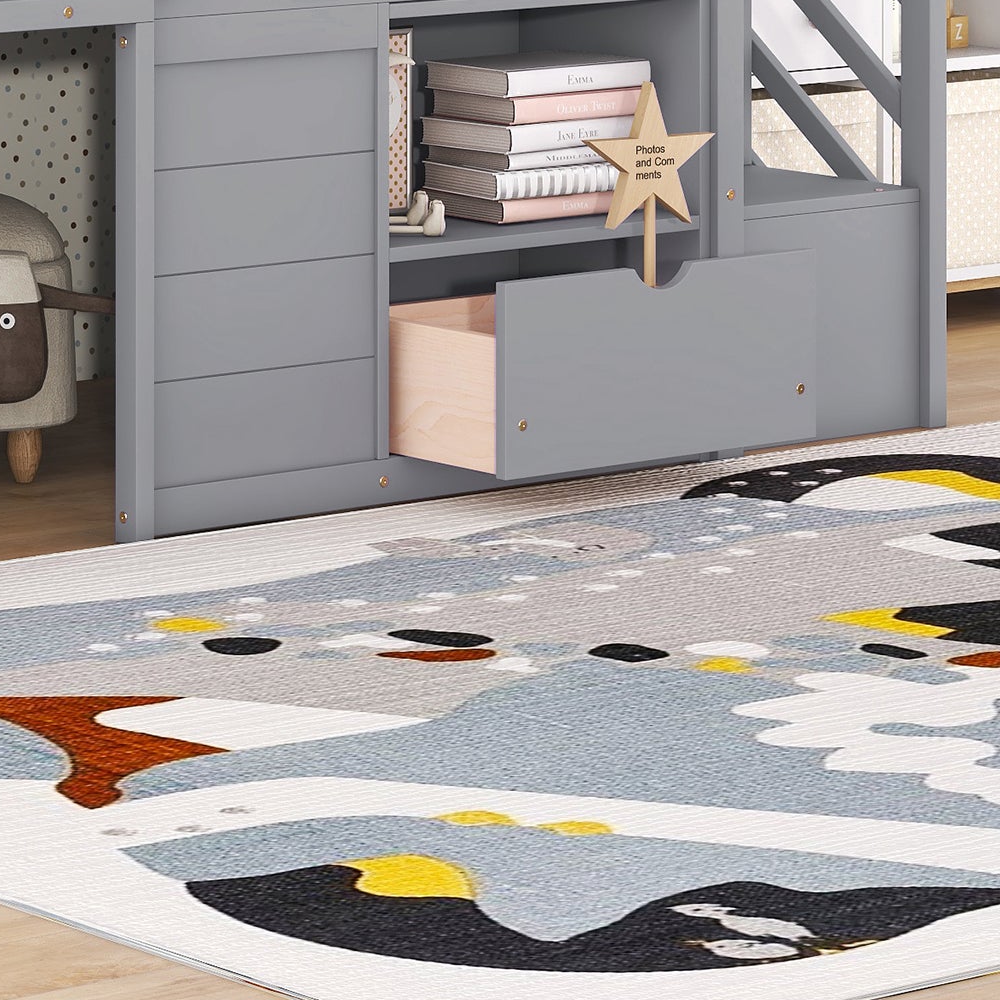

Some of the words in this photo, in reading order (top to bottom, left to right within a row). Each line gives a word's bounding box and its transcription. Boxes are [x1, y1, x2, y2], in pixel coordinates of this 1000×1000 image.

[635, 145, 666, 155] Photos
[635, 158, 652, 168] and
[654, 156, 675, 167] Com
[635, 170, 662, 181] ments
